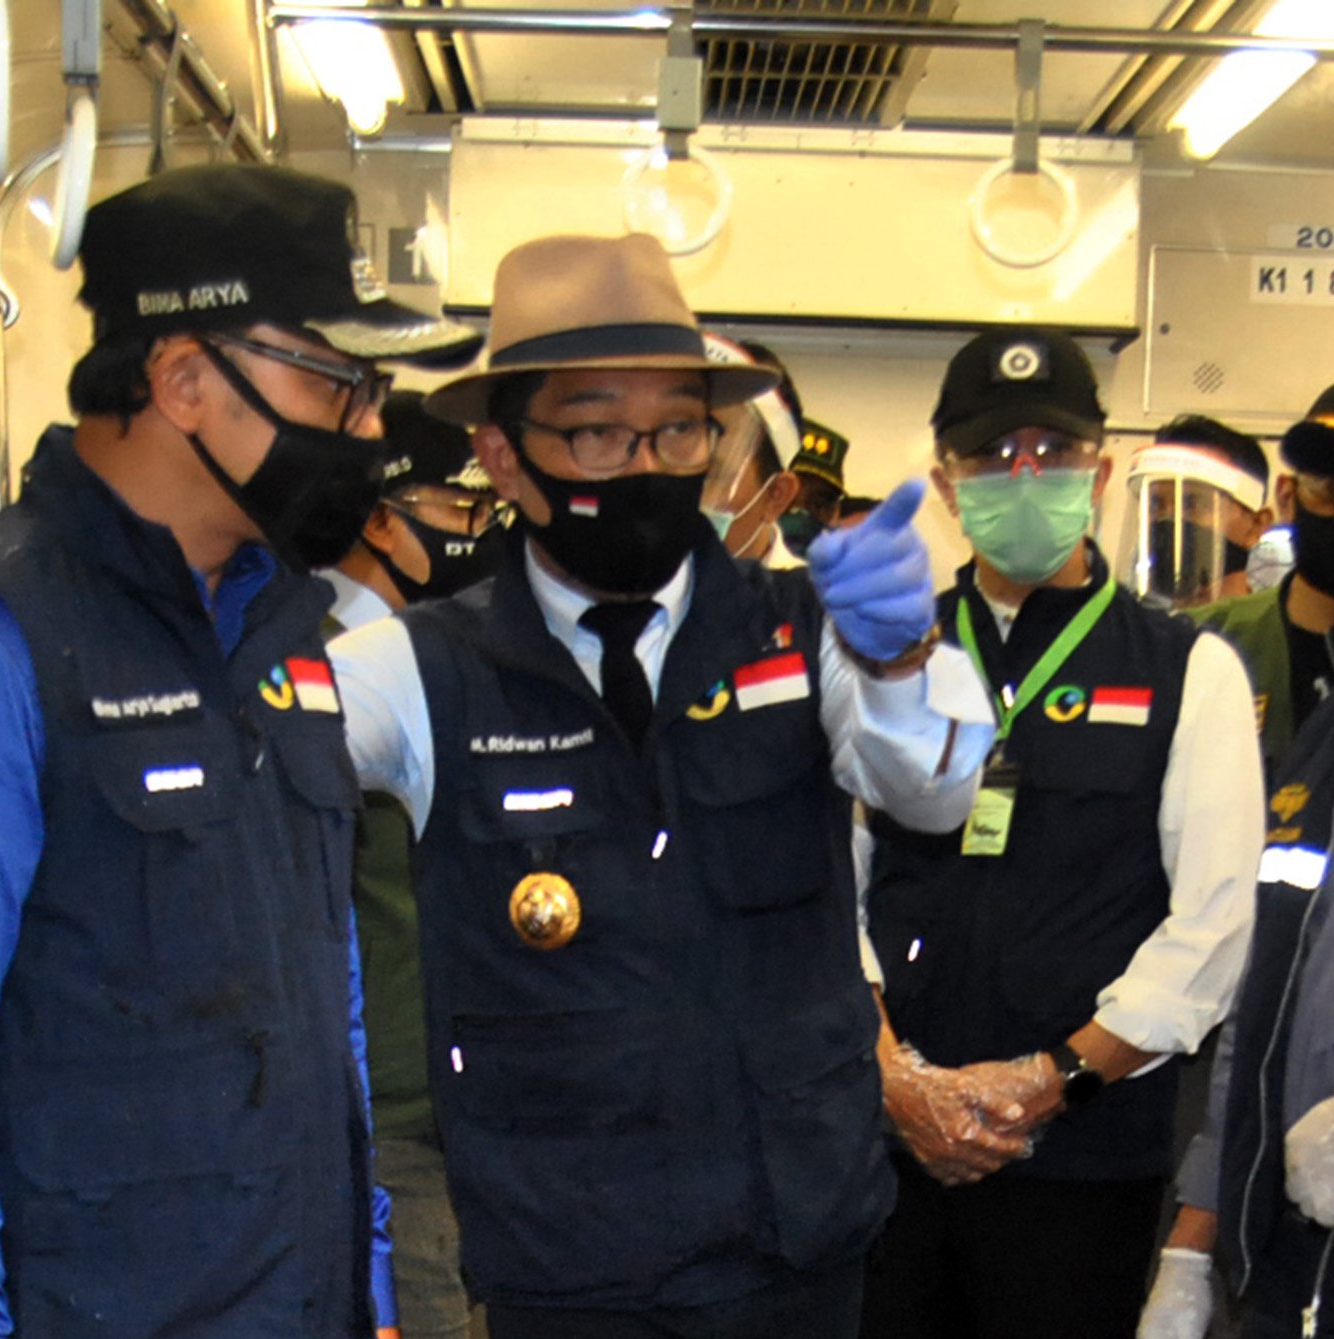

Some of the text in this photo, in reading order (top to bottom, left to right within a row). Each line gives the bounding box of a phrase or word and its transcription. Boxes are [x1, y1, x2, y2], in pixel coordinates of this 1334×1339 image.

[1259, 267, 1287, 293] K1
[1303, 268, 1314, 294] 1
[189, 282, 249, 310] ARYA
